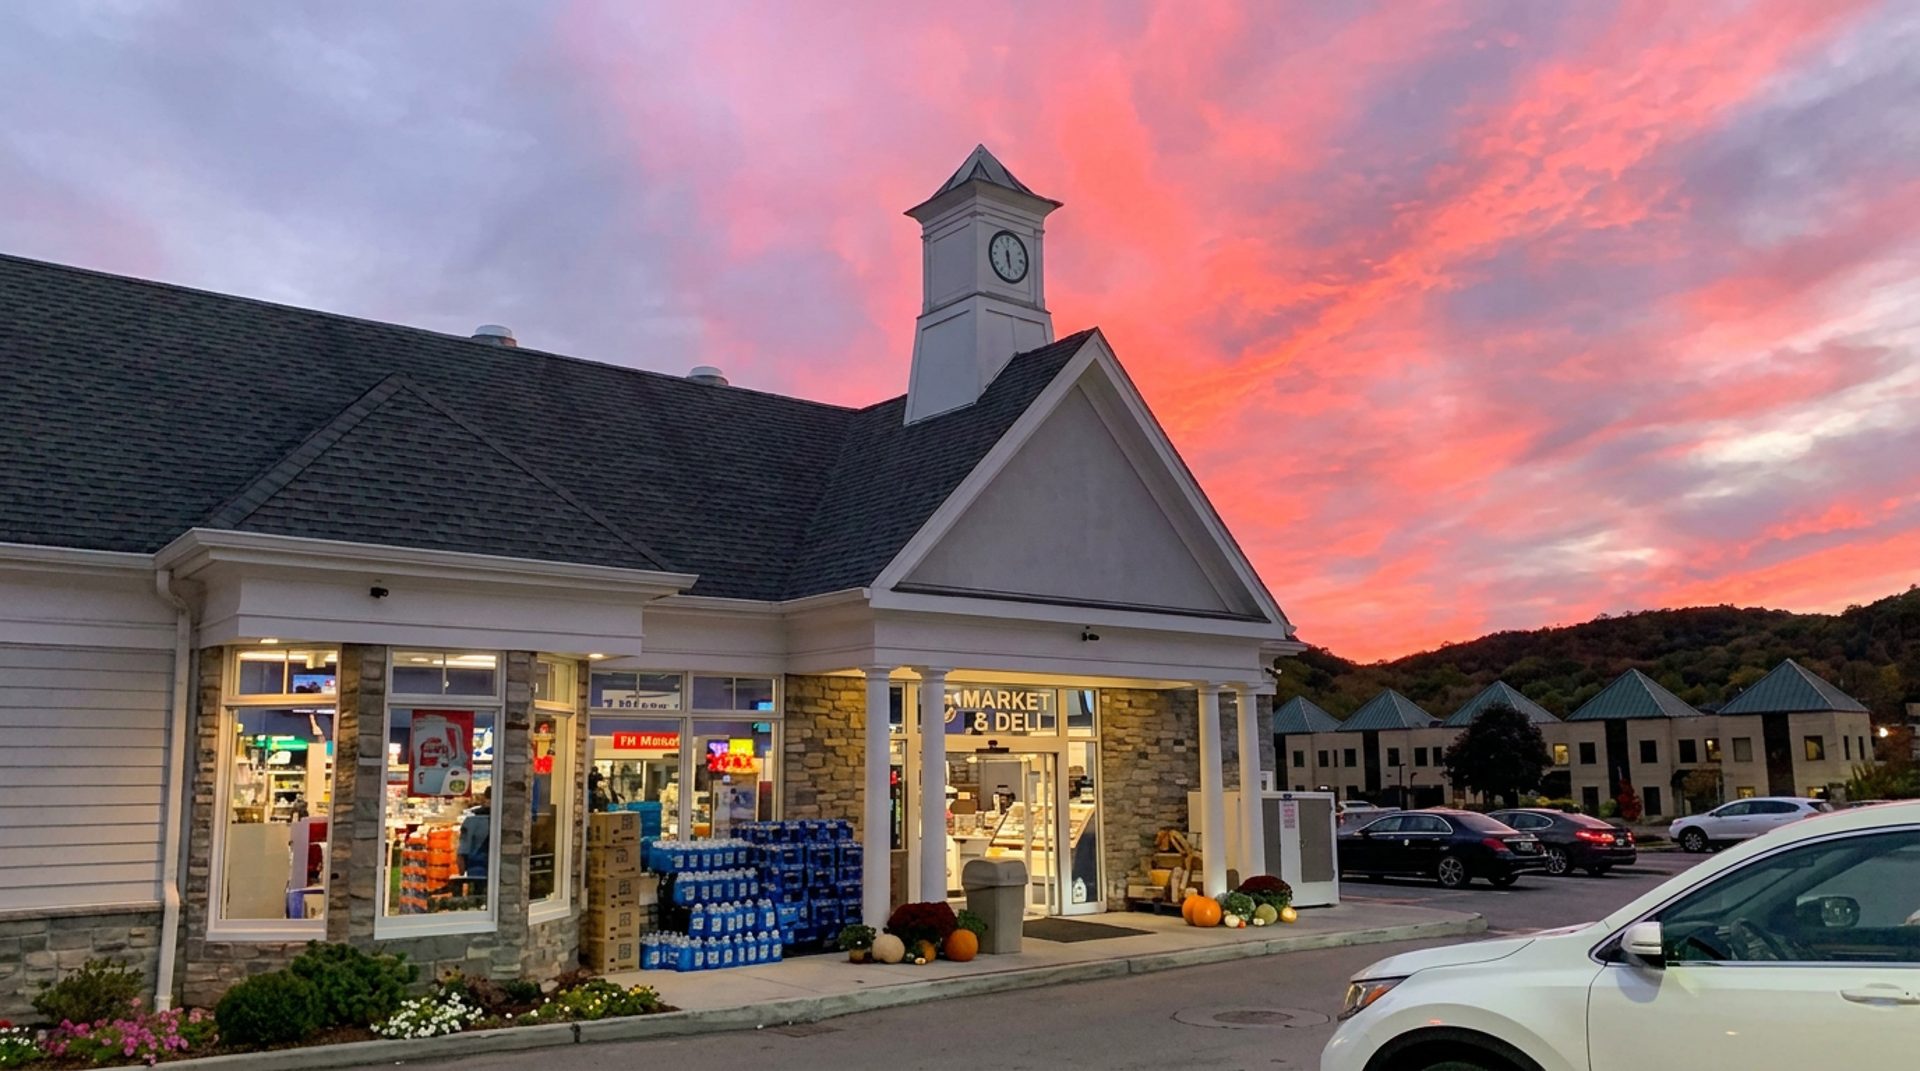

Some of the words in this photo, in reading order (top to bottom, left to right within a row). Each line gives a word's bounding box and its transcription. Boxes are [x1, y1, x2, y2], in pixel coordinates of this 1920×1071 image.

[963, 690, 1050, 711] MARKET
[974, 712, 988, 731] &
[995, 712, 1040, 731] DELI
